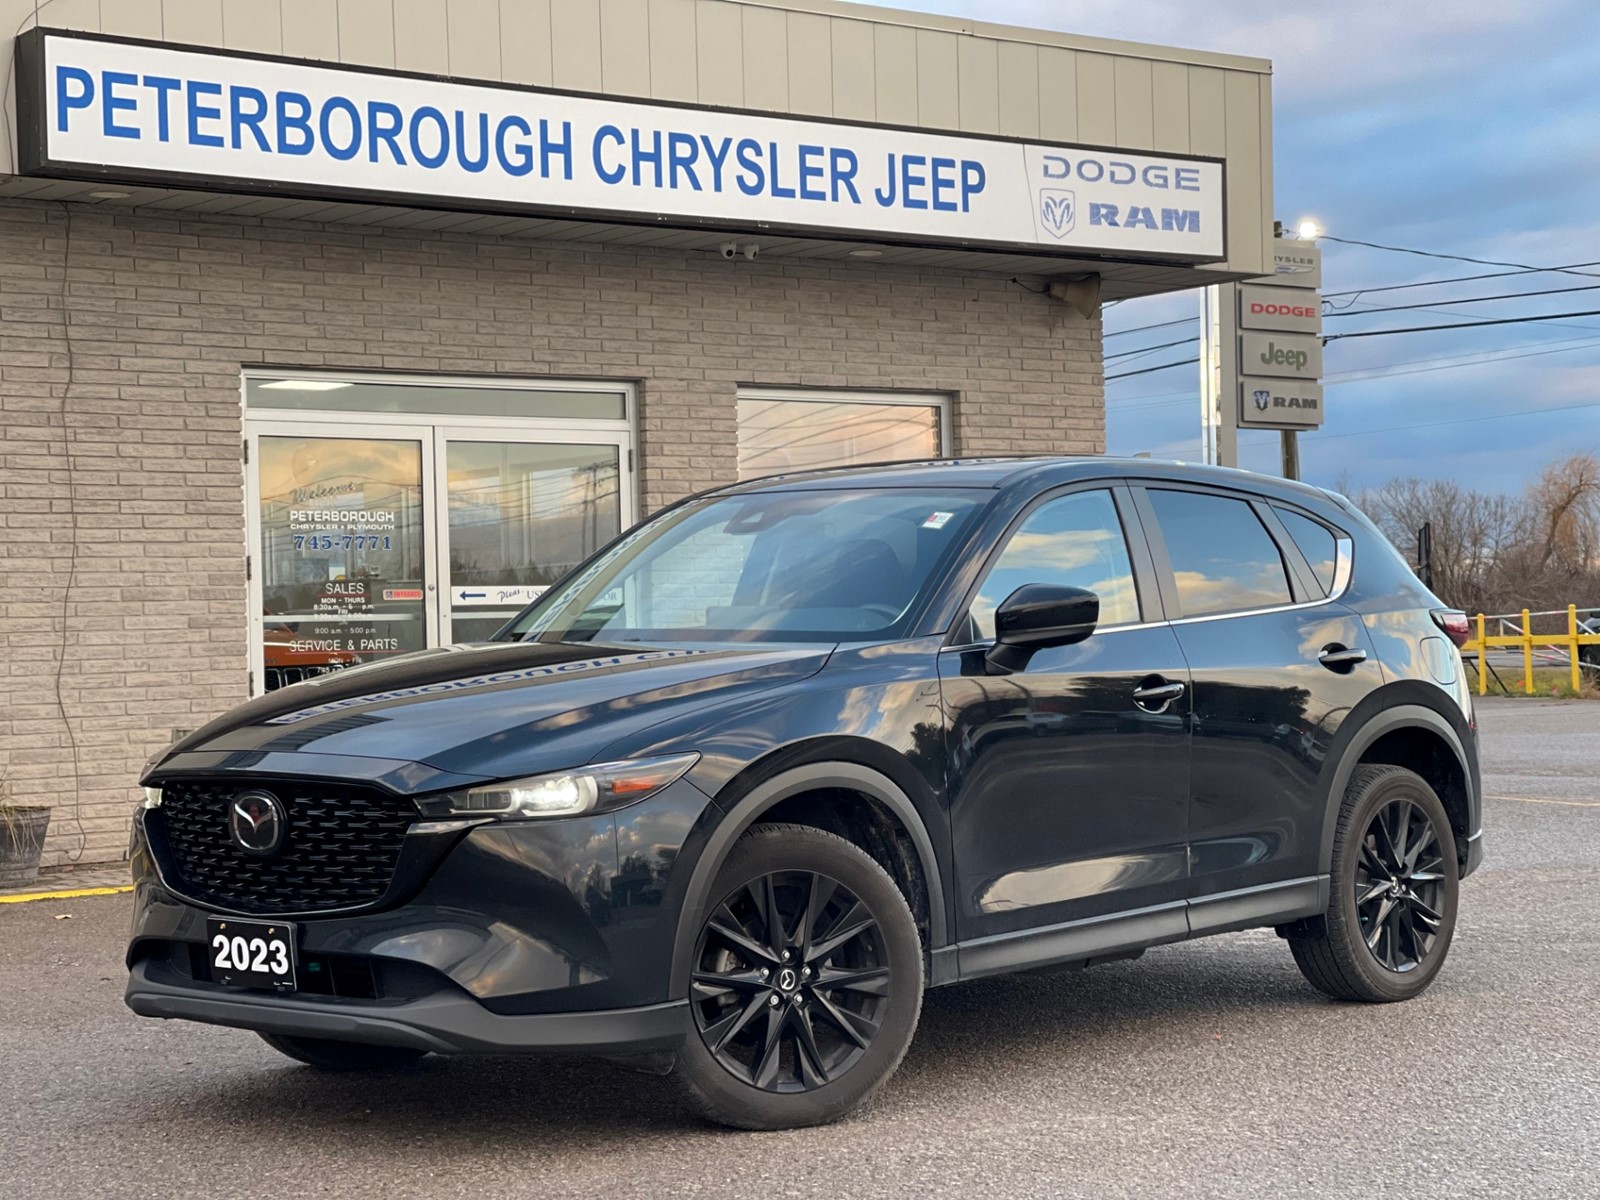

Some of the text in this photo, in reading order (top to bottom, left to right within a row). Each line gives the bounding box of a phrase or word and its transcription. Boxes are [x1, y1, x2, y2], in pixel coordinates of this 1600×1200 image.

[56, 64, 987, 214] PETERBOROUGH CHRYSLER JEEP
[1042, 154, 1201, 192] DODGE
[1088, 201, 1201, 233] RAM
[1274, 255, 1315, 266] YSLER
[1250, 302, 1316, 318] DODGE
[1260, 341, 1309, 371] Jeep
[1273, 396, 1318, 410] RAM
[289, 510, 395, 522] PETERBOROUGH
[293, 534, 392, 550] 745-7771
[325, 582, 365, 595] SALES
[497, 587, 524, 603] Pleas
[289, 638, 398, 652] SERVICE & PARTS
[212, 934, 289, 975] 2023
